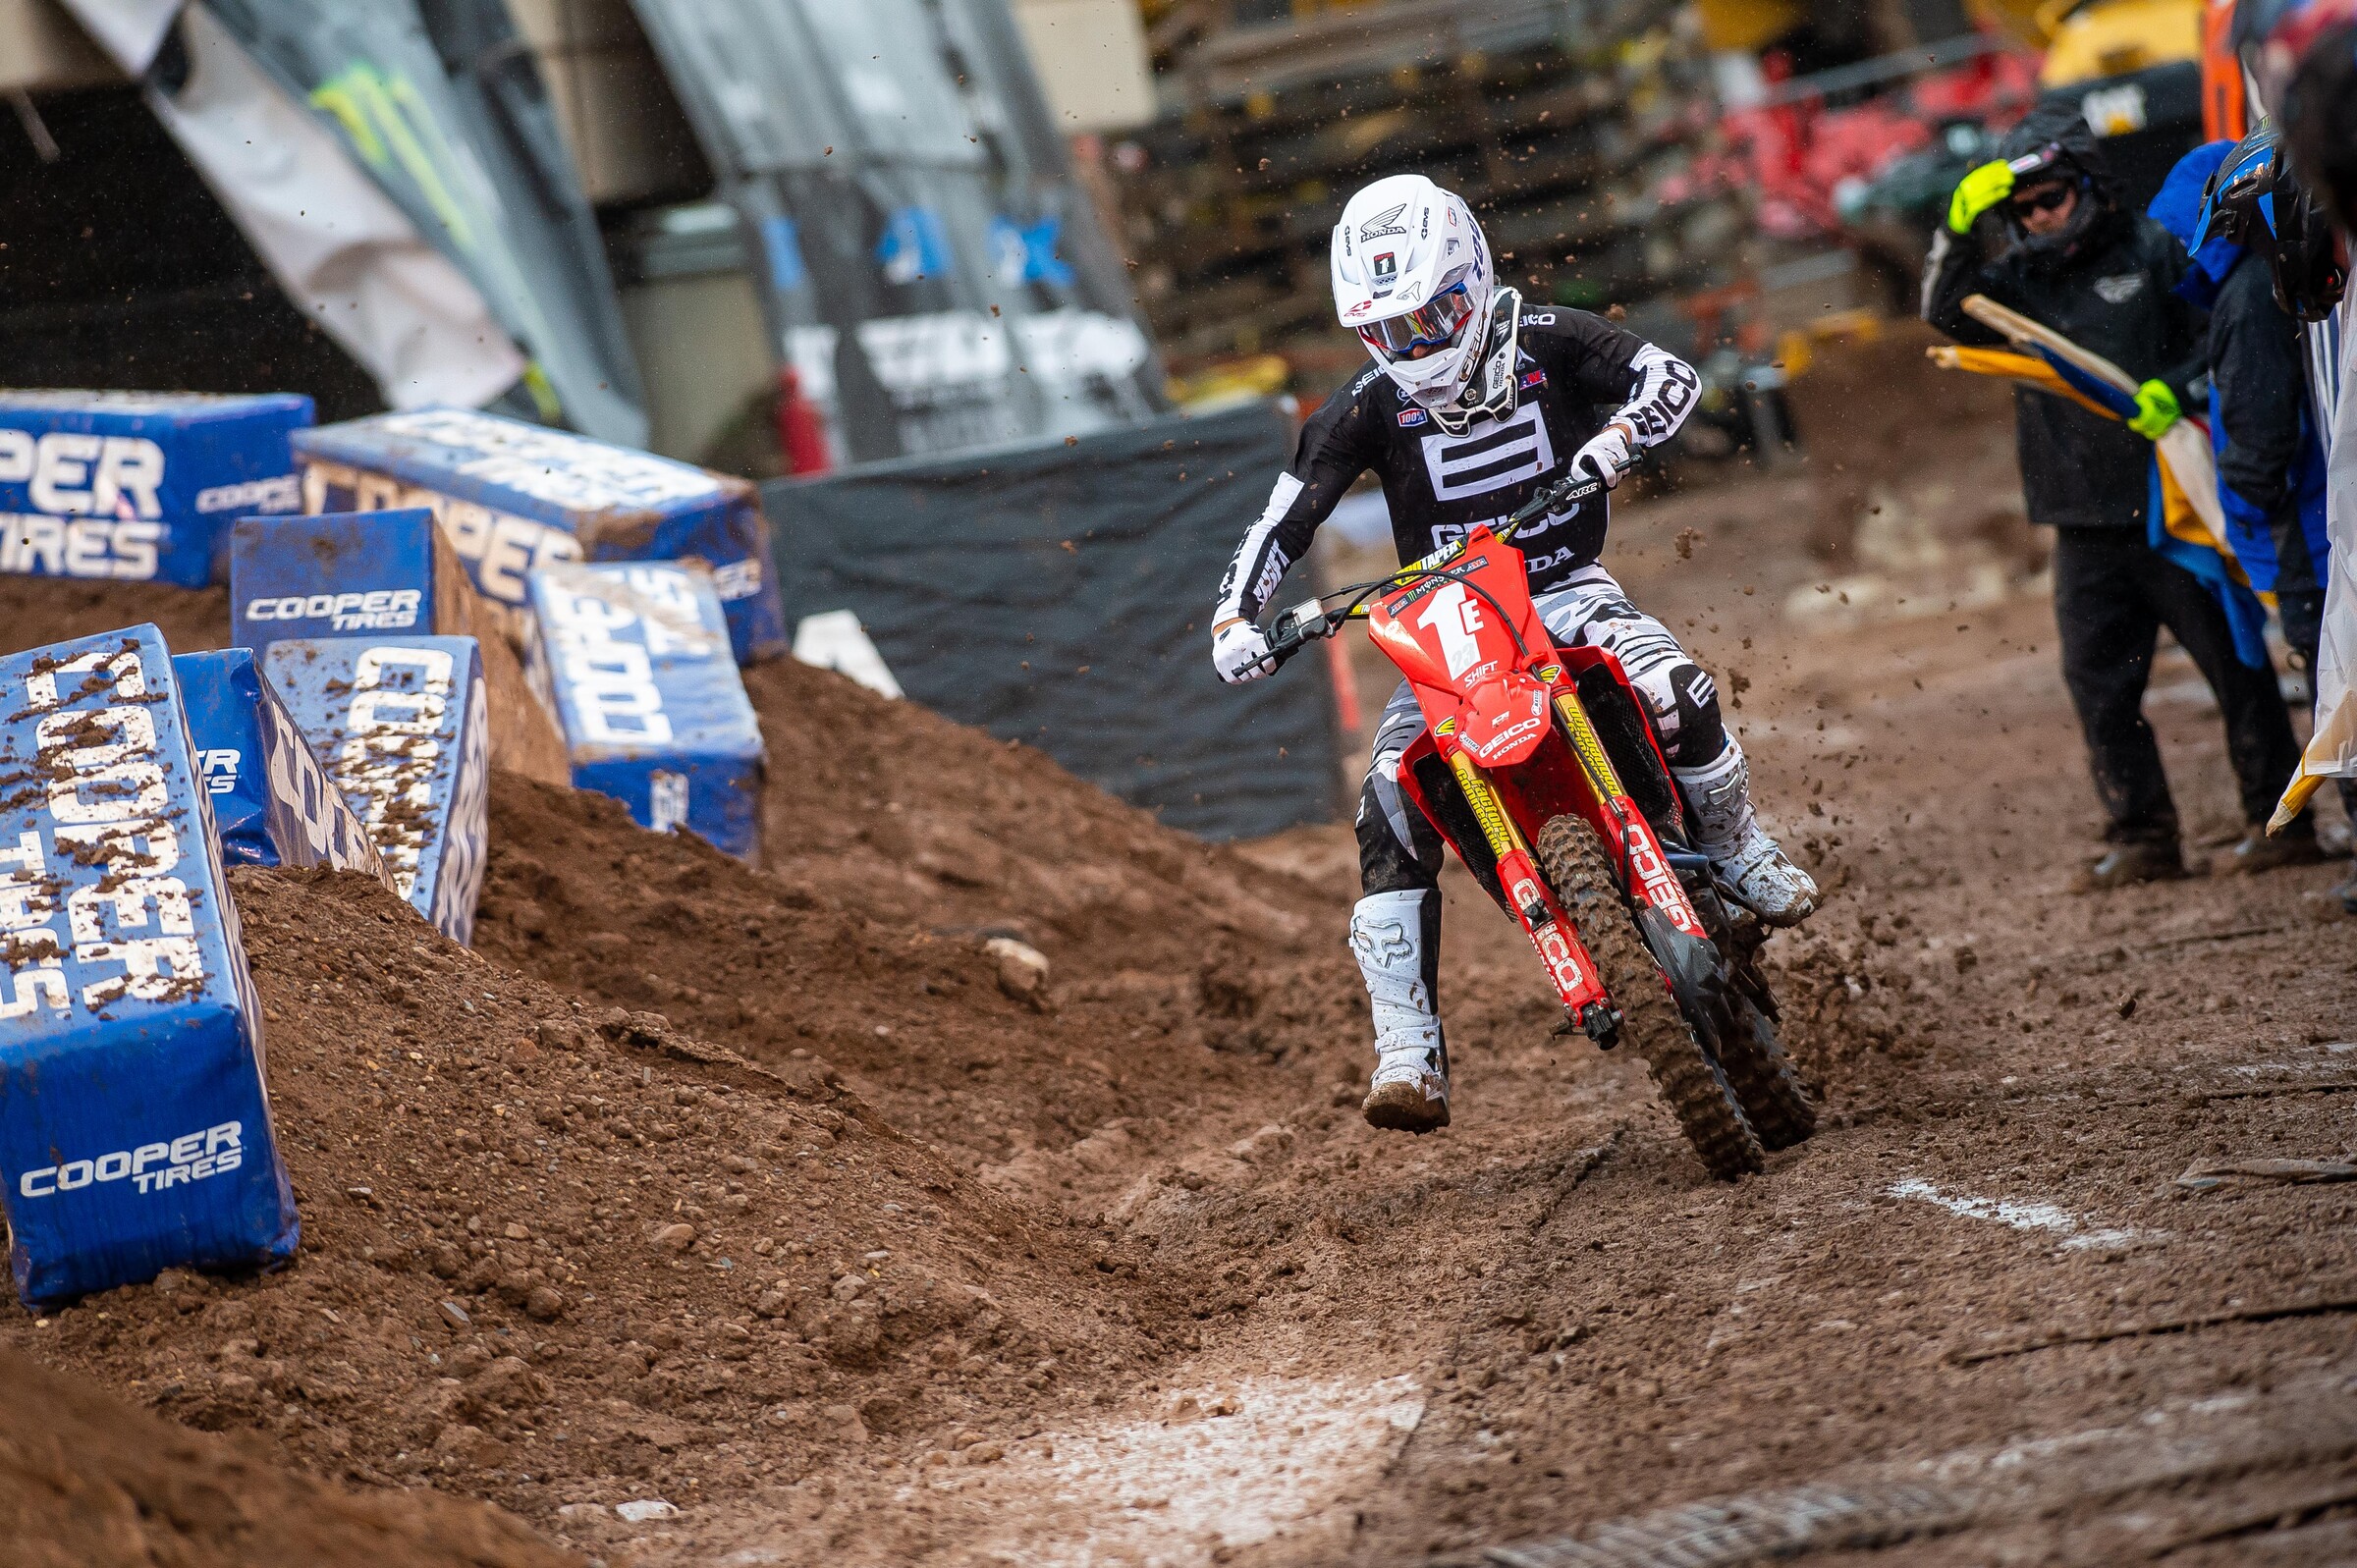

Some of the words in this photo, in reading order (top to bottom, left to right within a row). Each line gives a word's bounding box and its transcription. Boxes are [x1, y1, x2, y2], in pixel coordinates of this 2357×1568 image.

[1361, 226, 1406, 243] HONDA
[1493, 360, 1502, 389] GEICO
[1400, 412, 1425, 424] 100%
[1565, 482, 1598, 501] ARC
[247, 589, 422, 622] COOPER
[332, 610, 419, 631] TIRES
[1463, 660, 1499, 688] SHIFT
[1478, 718, 1542, 759] GEICO
[1492, 732, 1538, 761] HONDA
[27, 652, 205, 1006] COOPER
[1619, 824, 1692, 932] GEICO
[1512, 878, 1583, 993] GICO
[20, 1120, 243, 1198] COOPER
[132, 1148, 243, 1195] TIRES
